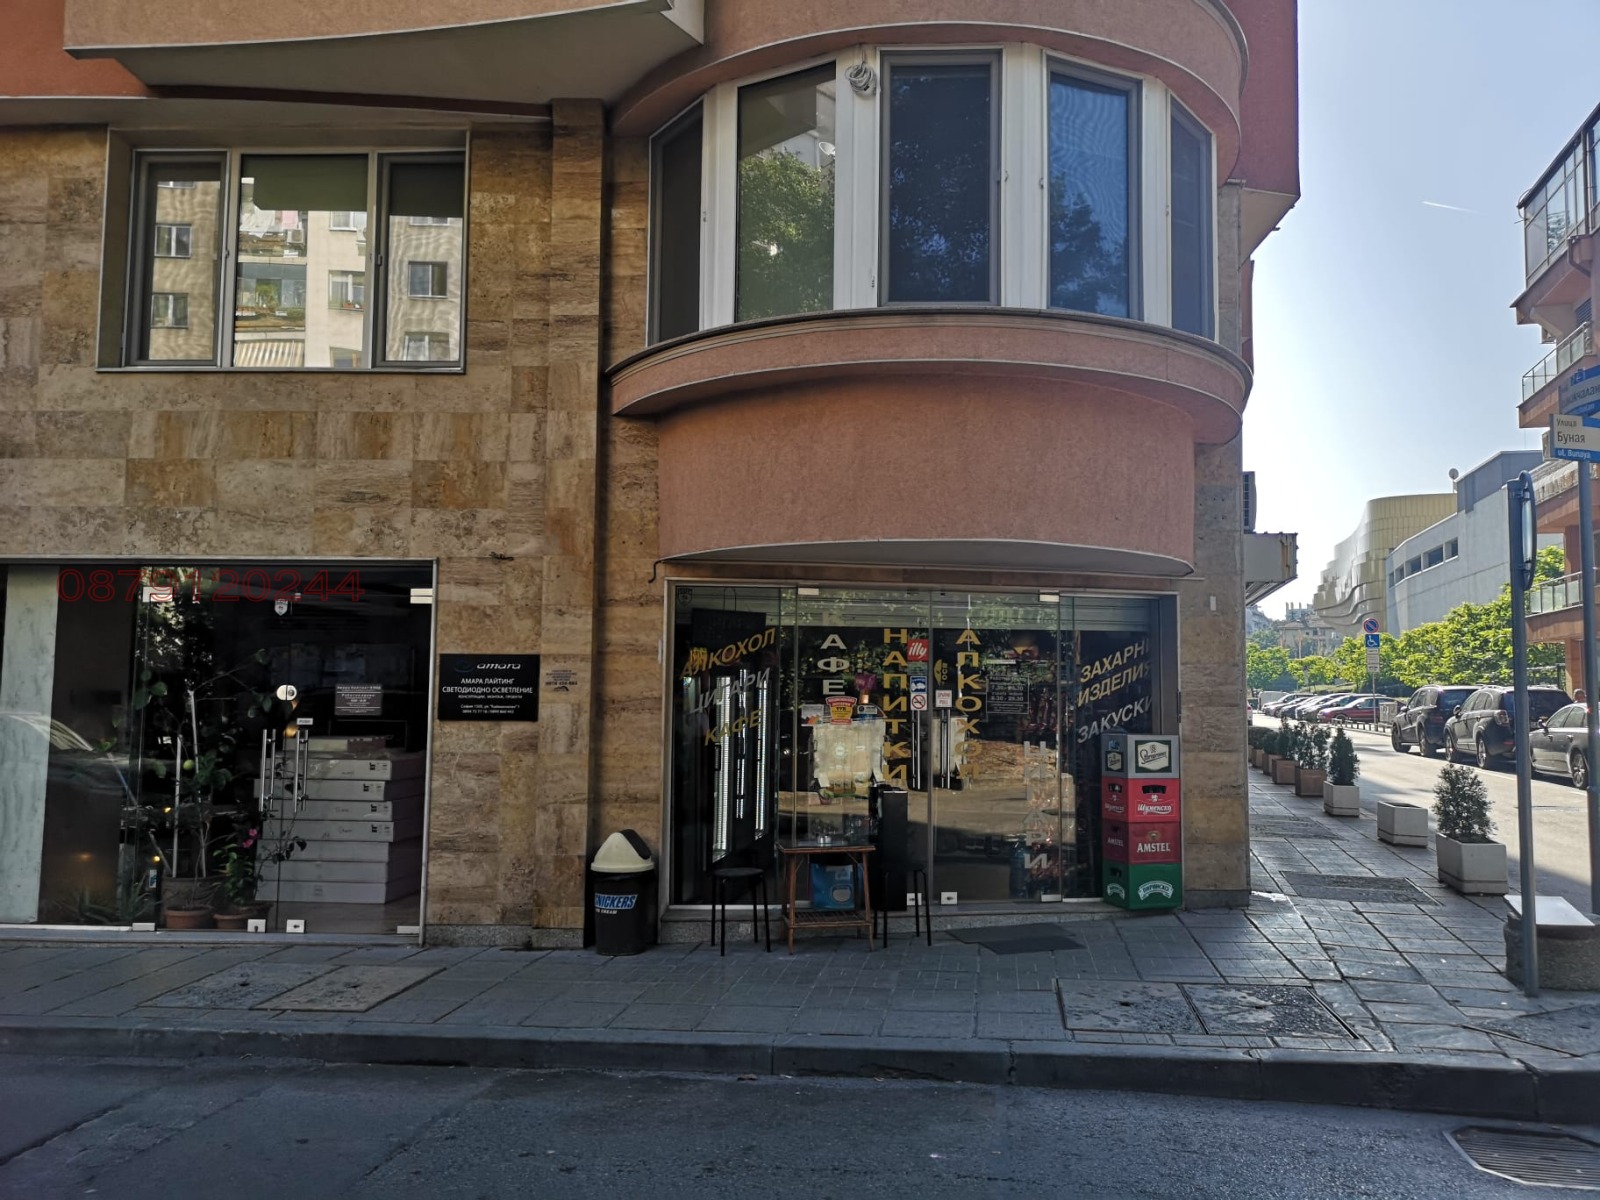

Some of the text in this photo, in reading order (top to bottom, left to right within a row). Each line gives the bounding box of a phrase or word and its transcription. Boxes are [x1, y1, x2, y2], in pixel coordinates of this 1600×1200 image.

[1557, 431, 1585, 445] Буная
[1567, 451, 1591, 461] Bunaya
[908, 642, 927, 659] illy
[484, 677, 515, 685] ЛАЙТИНГ
[883, 628, 909, 781] НАПИТКИ
[955, 629, 982, 778] АЛКОХОЛ
[704, 709, 763, 746] КАФЕ
[1137, 842, 1171, 853] AMSTEL
